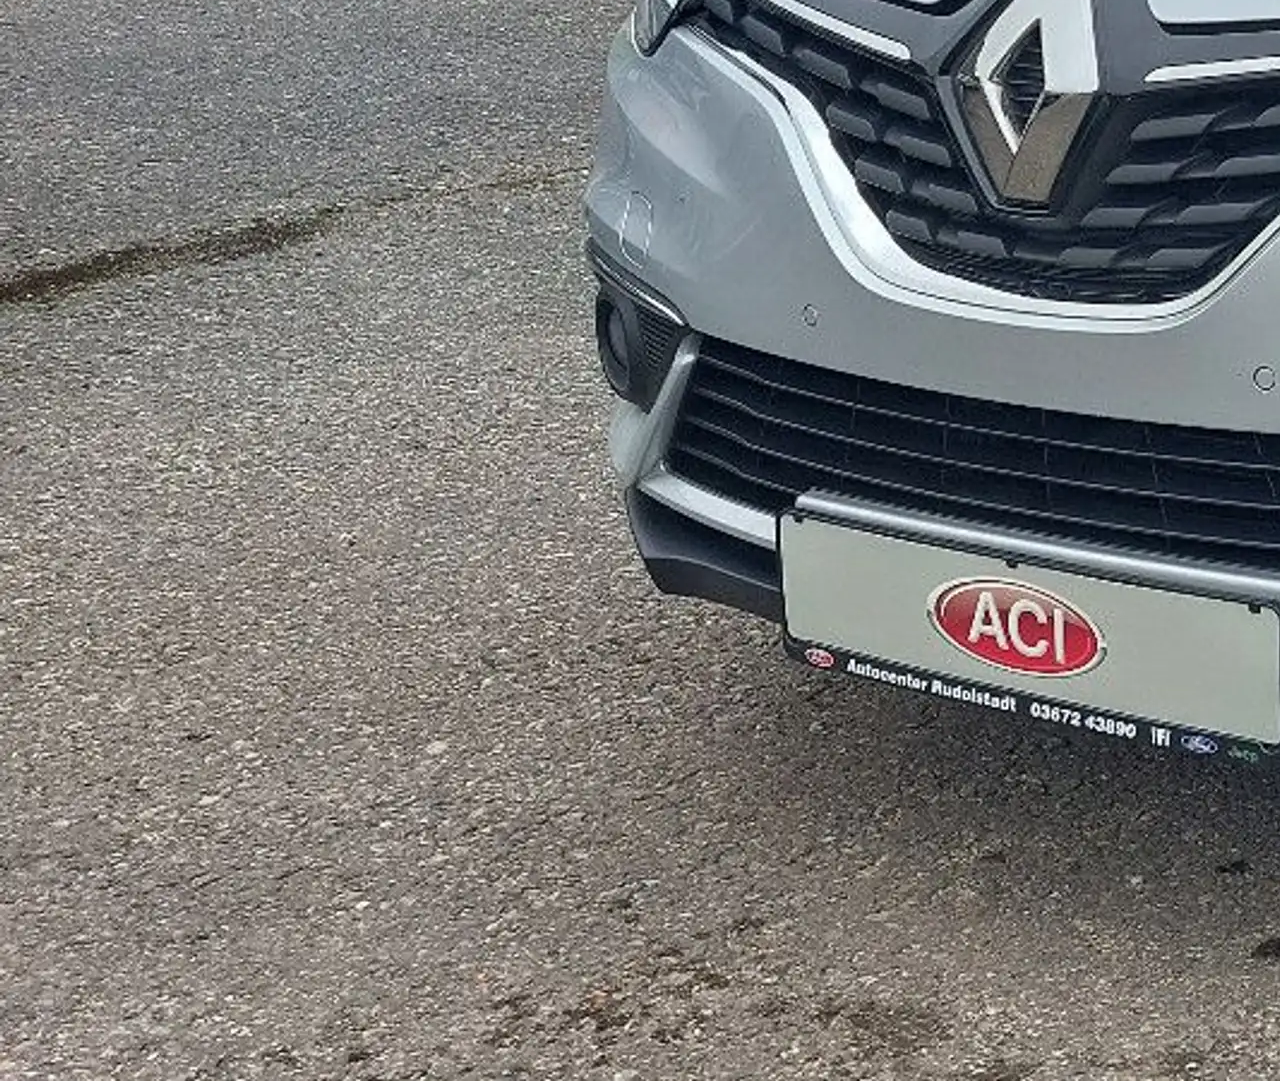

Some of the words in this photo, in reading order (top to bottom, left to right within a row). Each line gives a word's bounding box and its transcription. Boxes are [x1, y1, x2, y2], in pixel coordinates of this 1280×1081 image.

[967, 591, 1066, 665] ACI
[847, 659, 927, 692] Autocenter
[931, 679, 1017, 713] Rudolstadt
[1029, 701, 1082, 728] 03672
[1084, 715, 1137, 740] 43890
